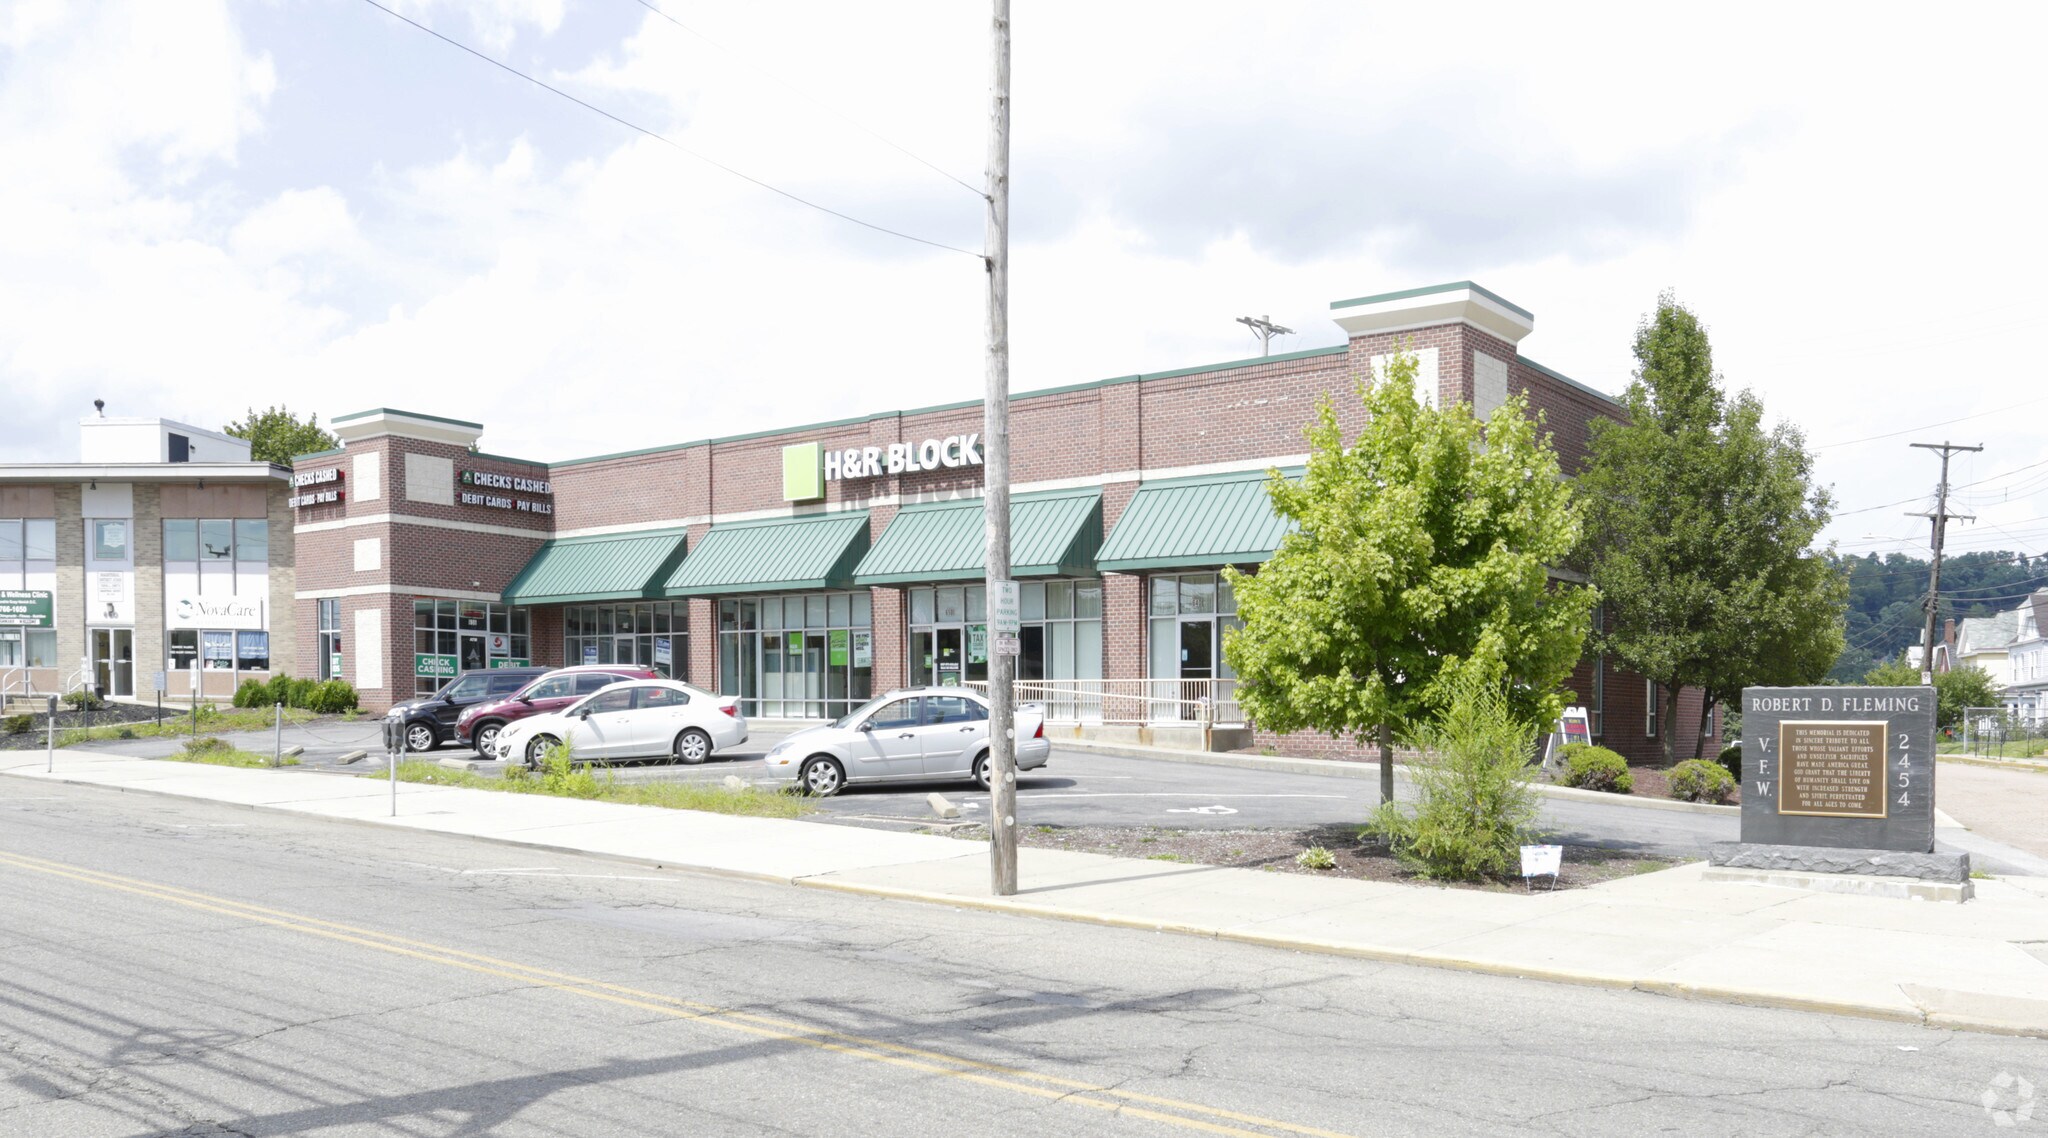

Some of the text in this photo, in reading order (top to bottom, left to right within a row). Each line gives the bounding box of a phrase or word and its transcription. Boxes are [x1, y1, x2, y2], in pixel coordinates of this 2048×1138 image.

[824, 433, 984, 480] H&R BLOCK
[294, 468, 337, 487] CHECKS CASHED
[474, 472, 512, 489] CHECKS
[513, 477, 551, 494] CASHED
[325, 490, 337, 502] BILLS
[462, 493, 551, 514] DEBIT CARDS PAY BILLS
[196, 602, 256, 617] NovaCare
[996, 608, 1018, 616] PARKING
[972, 633, 984, 642] TAX
[422, 658, 450, 666] CHCK
[418, 665, 454, 674] CASING
[1752, 697, 1919, 712] ROBERT D. FLEMING
[1758, 738, 1771, 752] V.
[1759, 760, 1770, 774] F.
[1756, 782, 1772, 796] W.
